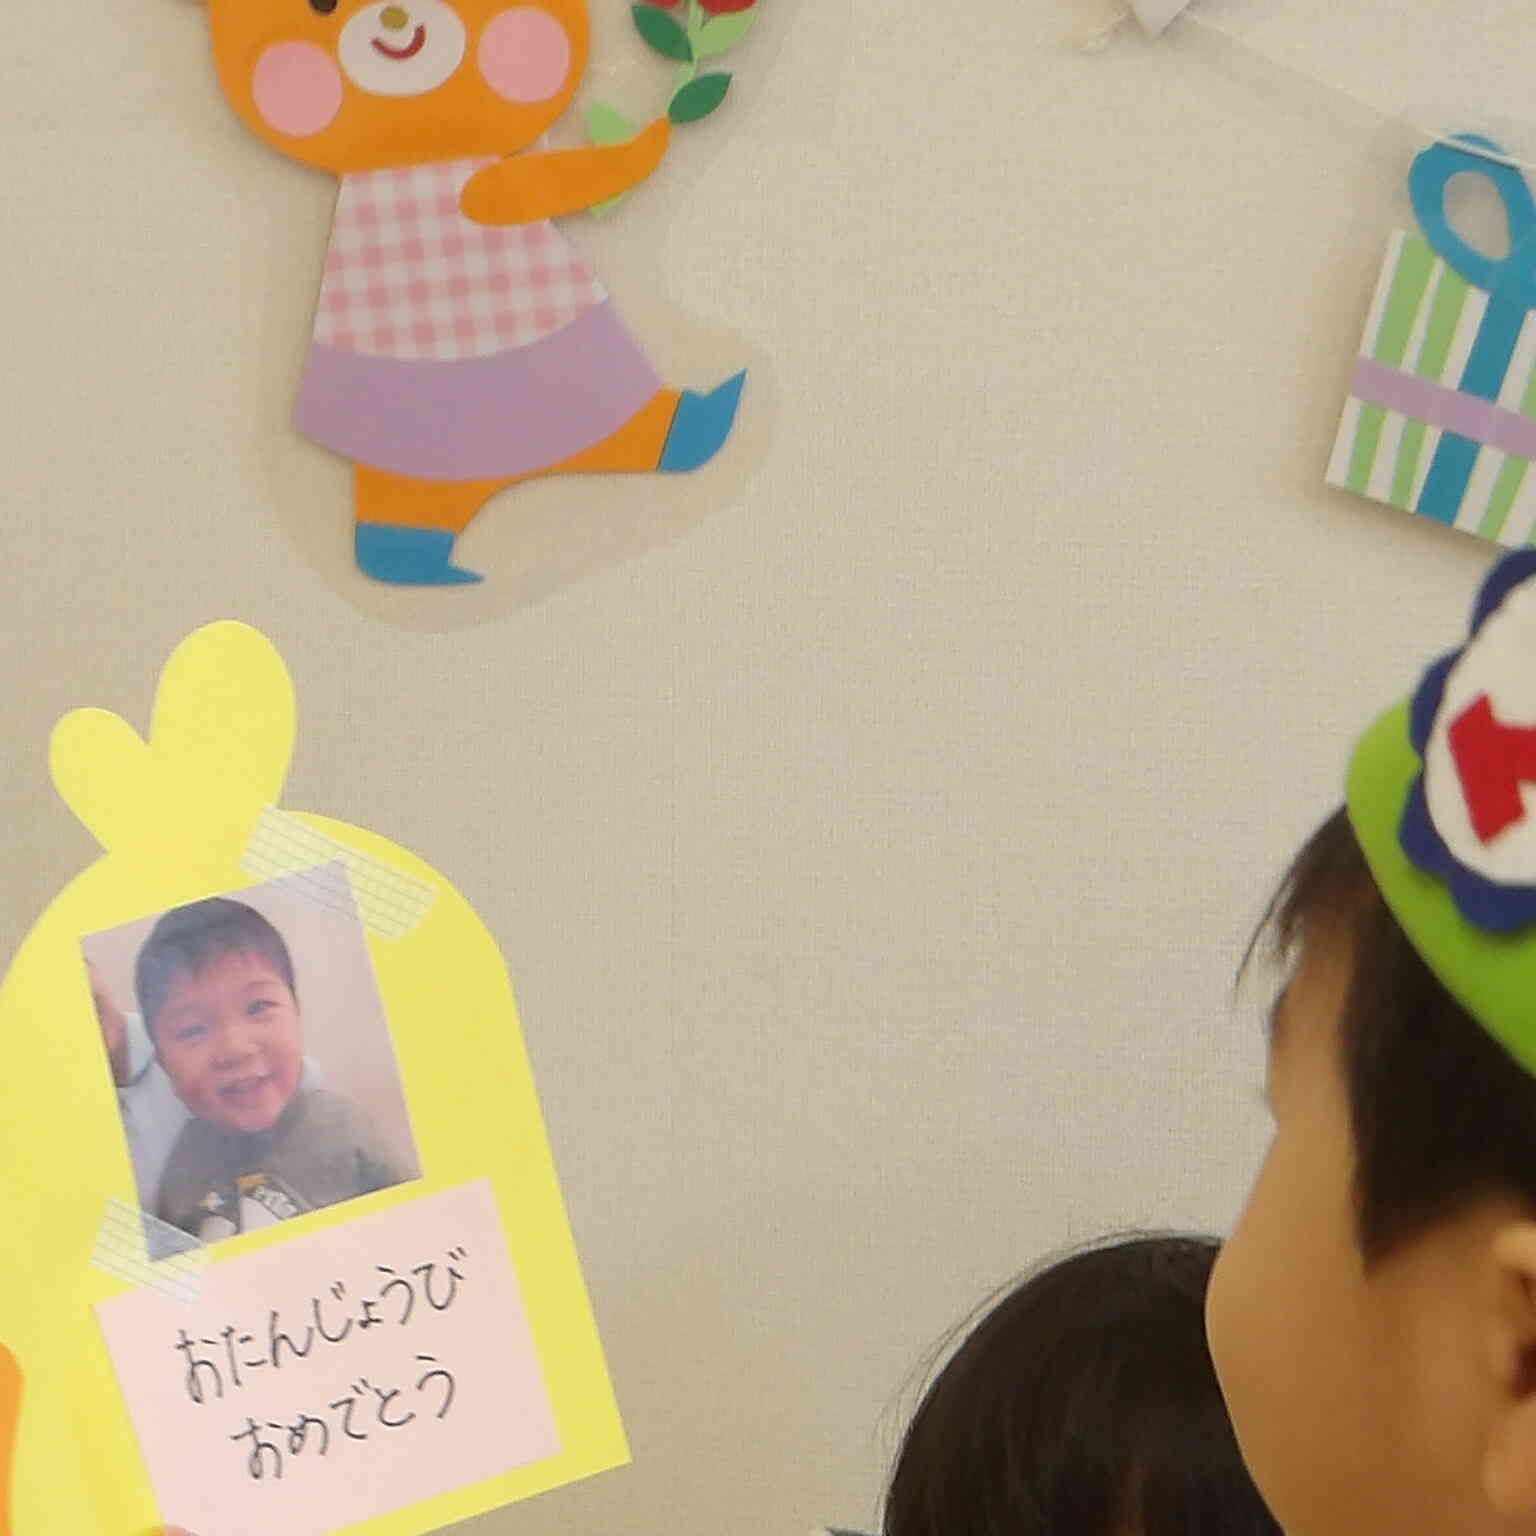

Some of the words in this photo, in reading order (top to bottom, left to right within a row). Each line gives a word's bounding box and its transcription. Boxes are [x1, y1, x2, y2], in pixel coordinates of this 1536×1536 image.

[174, 1246, 467, 1405] おたんじょうび
[229, 1354, 456, 1481] おめでとう
